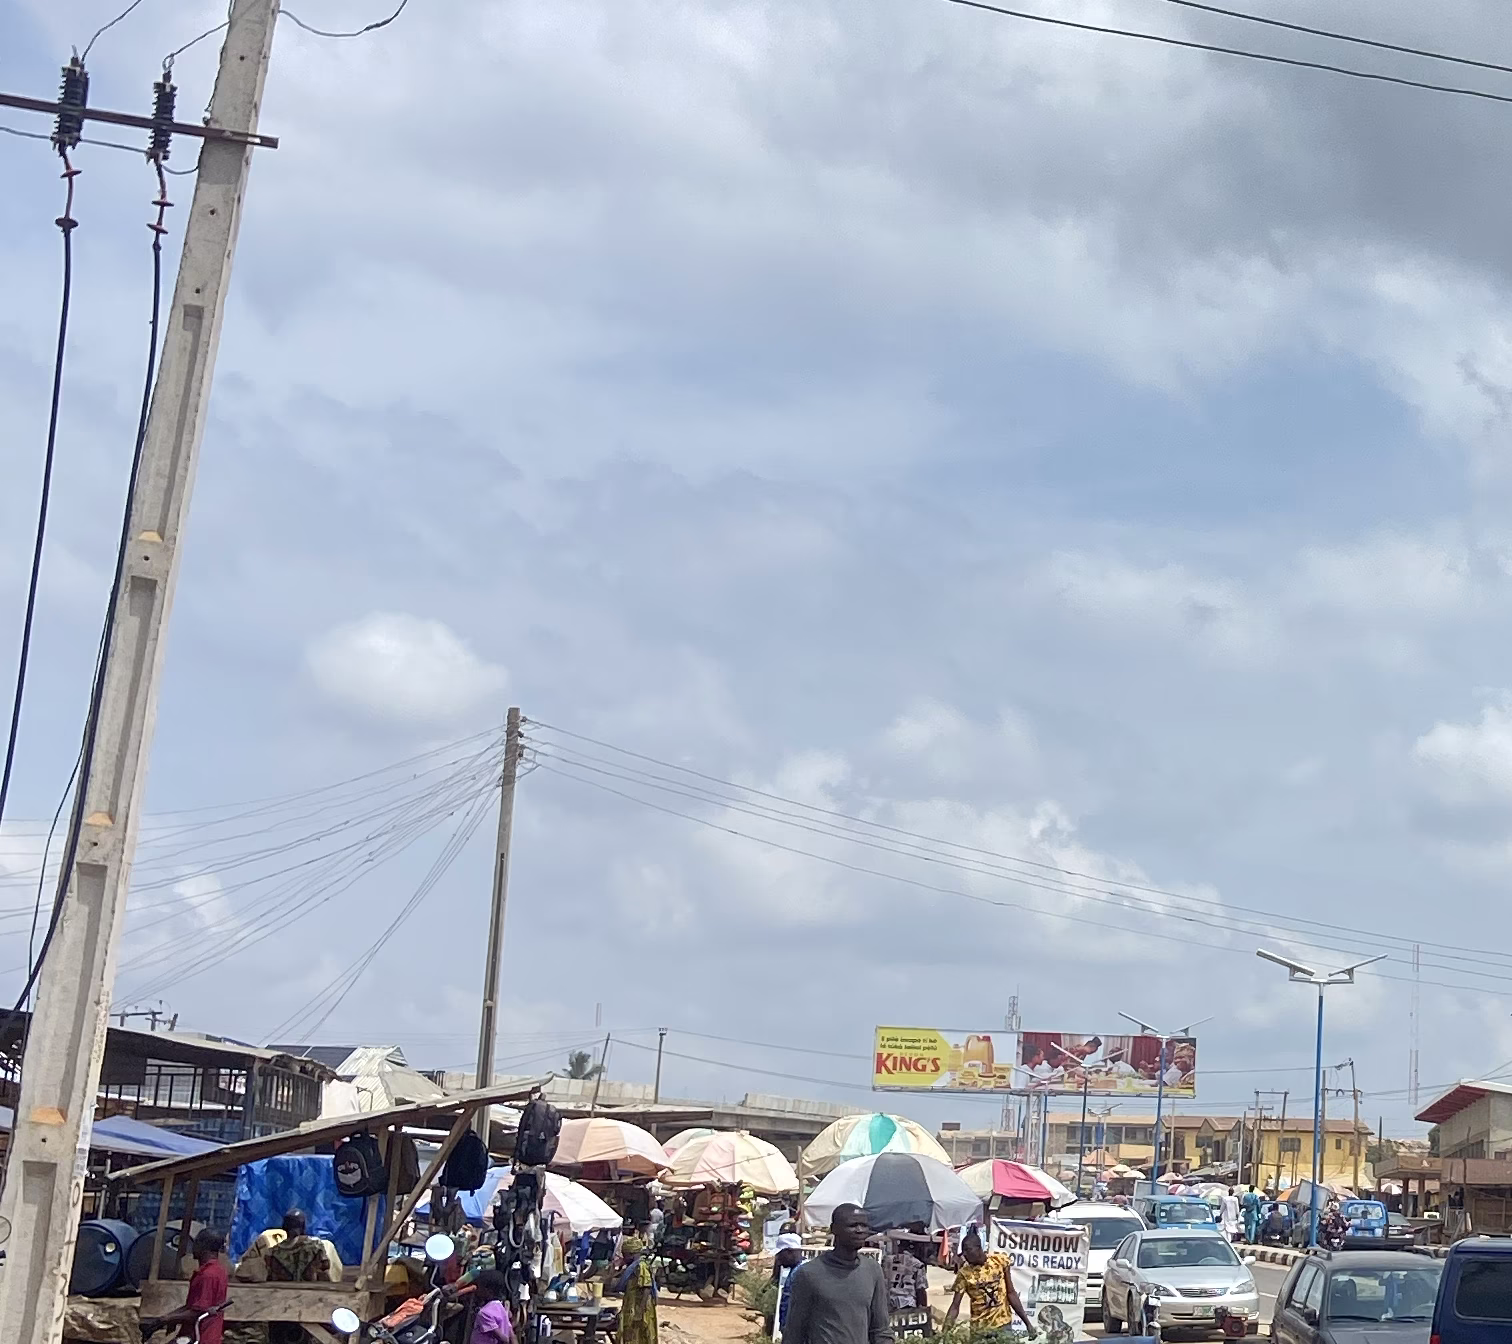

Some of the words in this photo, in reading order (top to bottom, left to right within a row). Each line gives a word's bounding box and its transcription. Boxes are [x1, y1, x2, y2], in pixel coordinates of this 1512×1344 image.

[875, 1052, 941, 1075] KING'S
[1028, 1254, 1039, 1268] IS
[1042, 1256, 1082, 1270] READY
